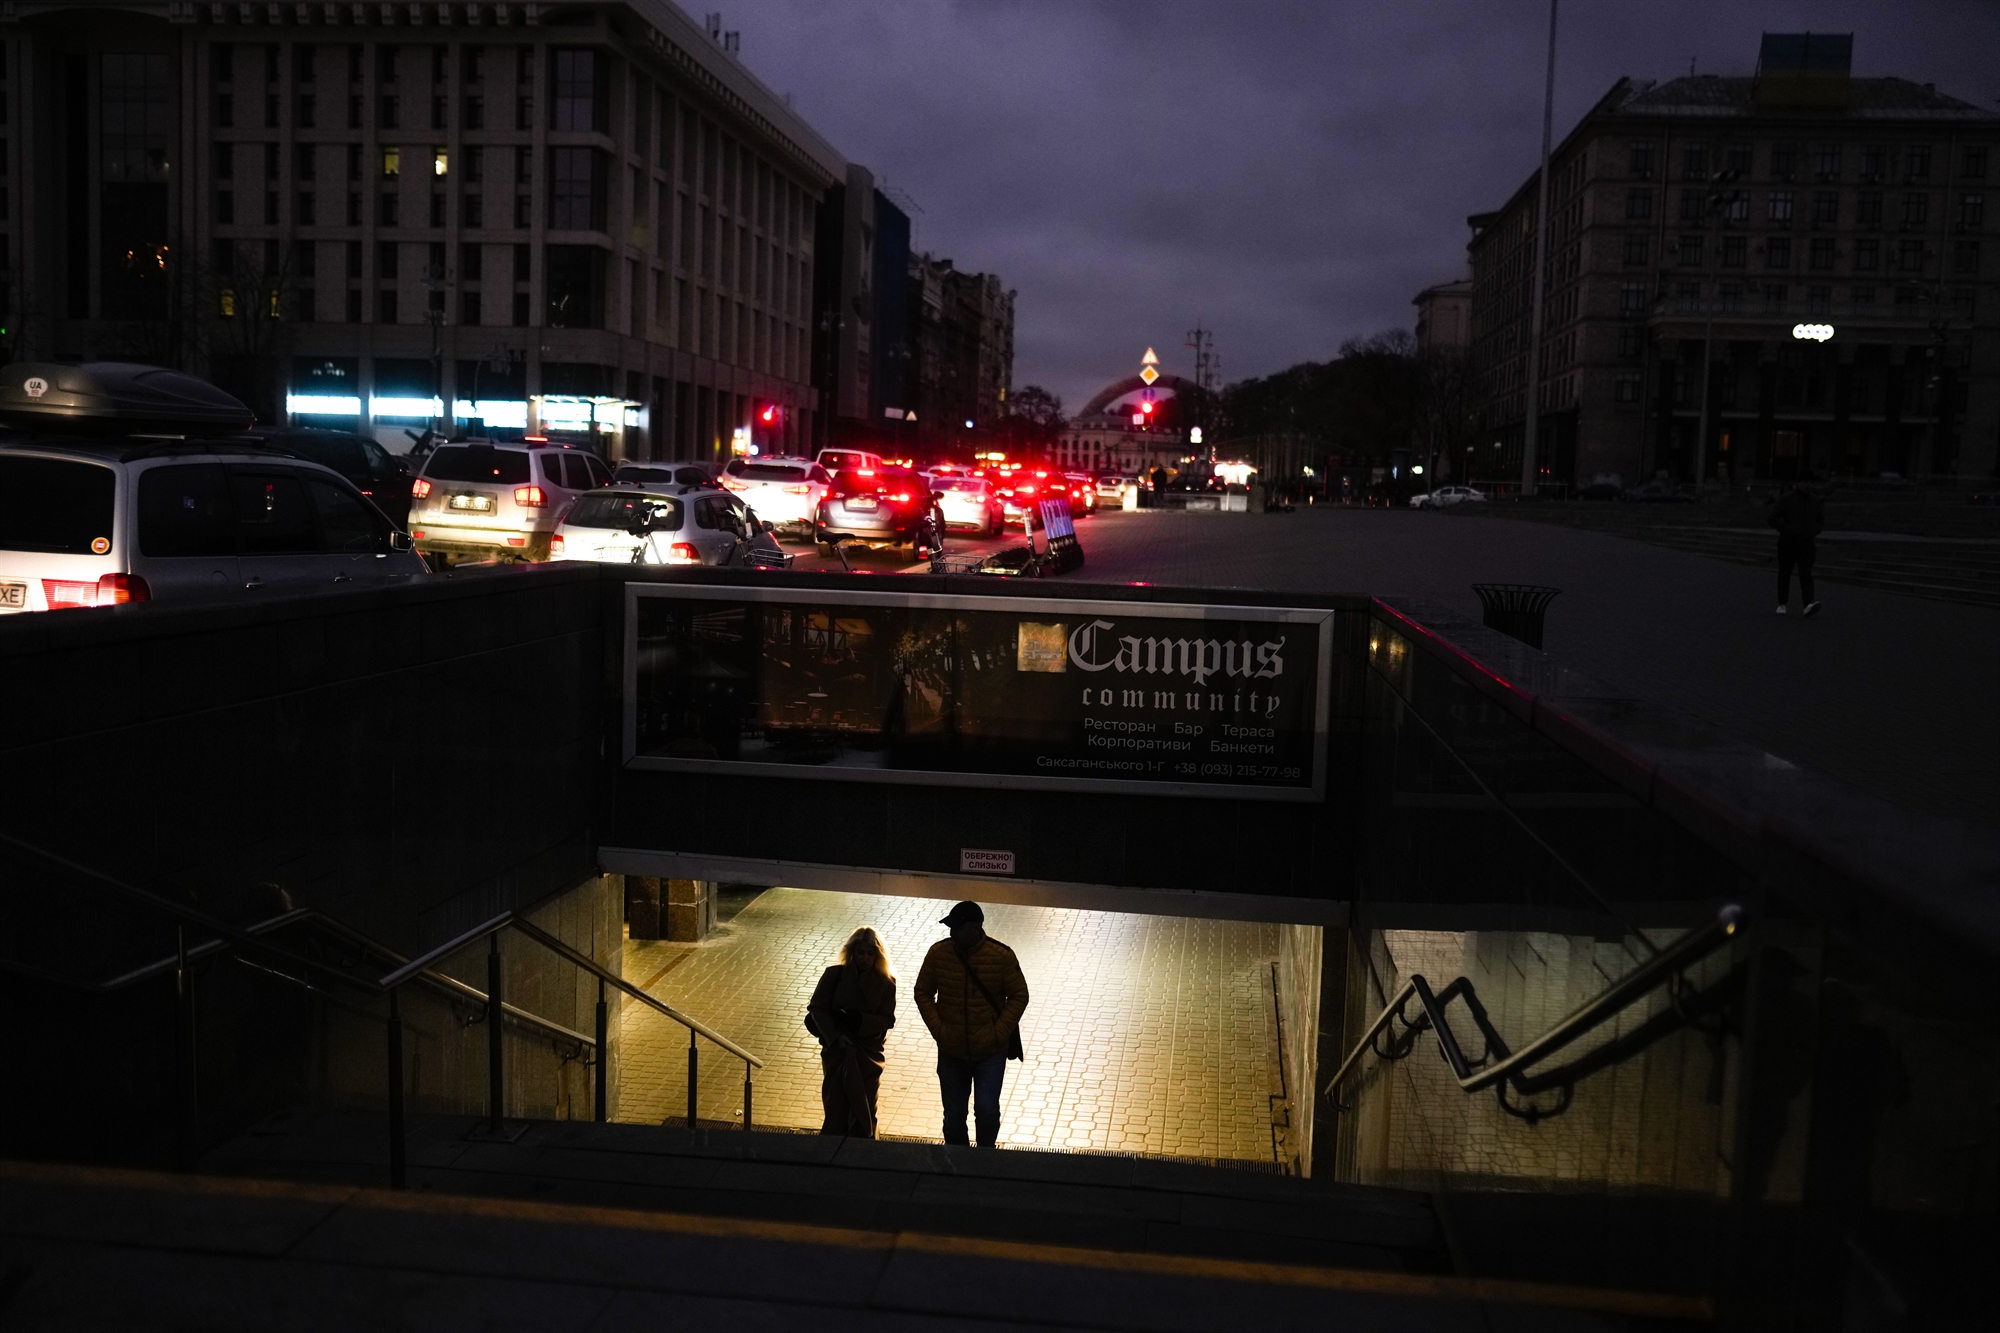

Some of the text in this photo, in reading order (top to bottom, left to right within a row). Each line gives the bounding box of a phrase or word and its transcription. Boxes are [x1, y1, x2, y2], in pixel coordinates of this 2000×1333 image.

[29, 381, 42, 390] UA
[0, 588, 20, 603] XE
[1068, 619, 1287, 687] Campus
[1081, 687, 1281, 719] community
[1083, 717, 1275, 739] Ресторан Бар Тераса
[1087, 734, 1275, 755] Корпоративи Банкети
[1036, 755, 1301, 779] Саксаганського 1-Г +38 (093) 215-77-98
[964, 851, 1013, 862] ОБЕРЕЖНО!
[968, 861, 1008, 871] СЛИЗЬКО
